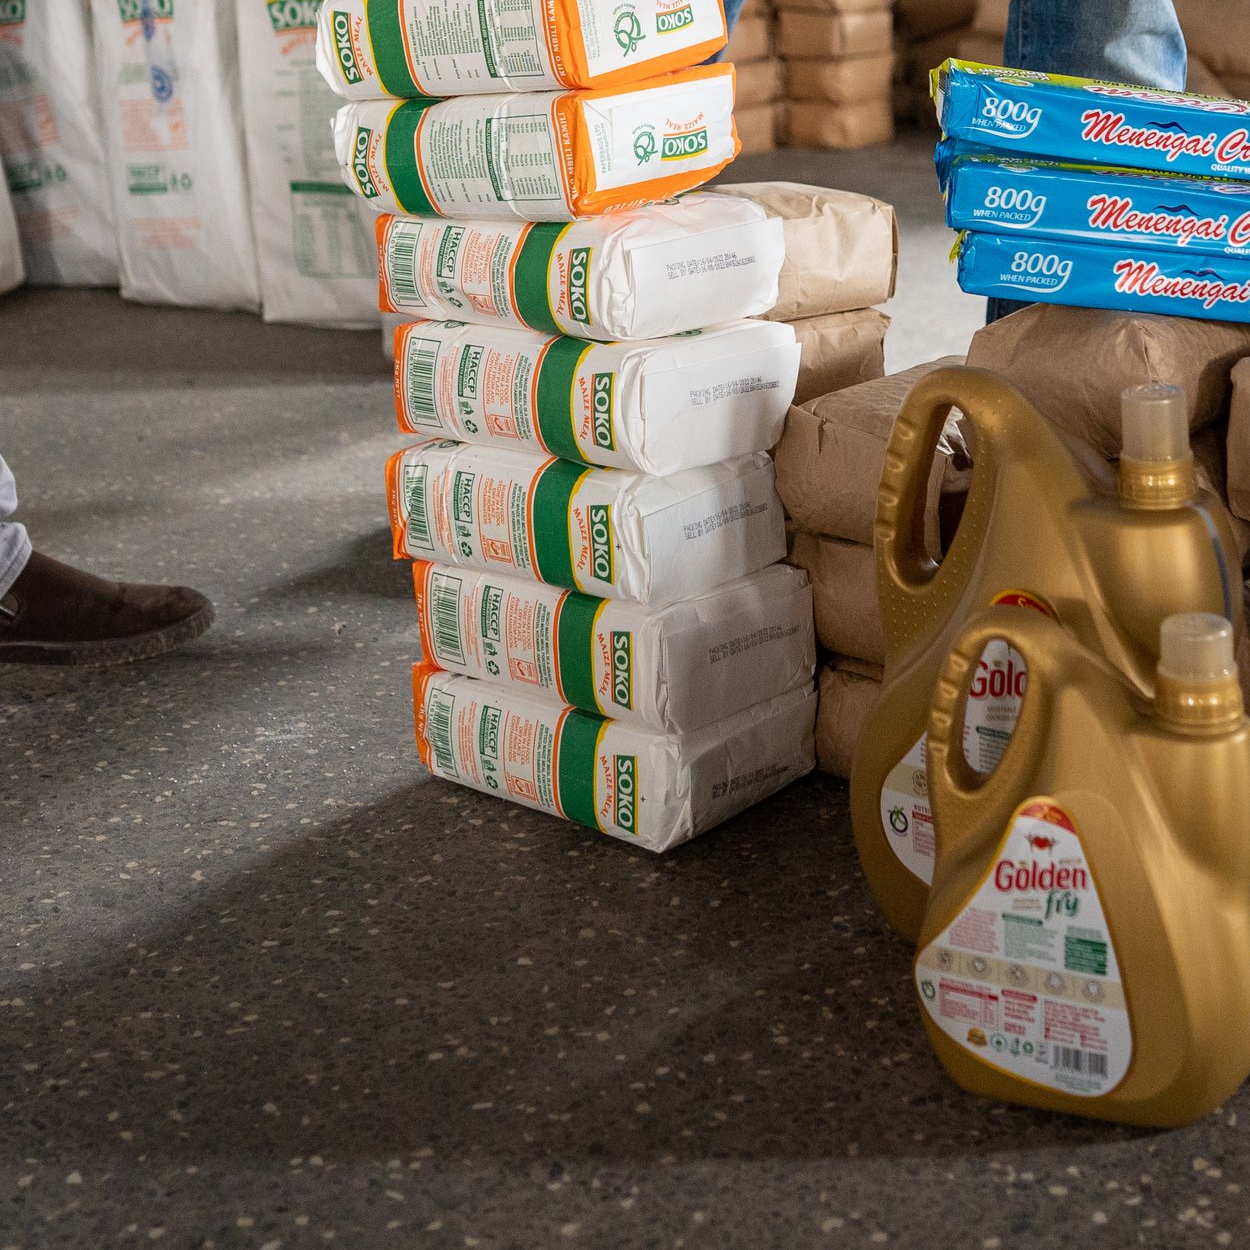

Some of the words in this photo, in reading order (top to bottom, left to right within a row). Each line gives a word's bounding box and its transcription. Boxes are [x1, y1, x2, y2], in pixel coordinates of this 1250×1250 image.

[353, 16, 363, 42] MEAL
[478, 0, 489, 37] INFORMATION
[657, 6, 692, 31] SOKO
[334, 14, 360, 82] SOKO
[550, 25, 560, 52] MBILI
[354, 45, 374, 77] MAIZE
[558, 112, 571, 145] KAMILI
[664, 118, 680, 131] MEAL
[680, 111, 705, 130] MAIZE
[982, 96, 1043, 130] 800g
[370, 133, 382, 160] MEAL
[485, 122, 493, 160] INFORMATION
[665, 133, 707, 155] SOKO
[1081, 109, 1217, 163] Menengai
[354, 131, 376, 196] SOKO
[371, 164, 389, 193] MAIZE
[566, 148, 575, 174] MBILI
[1211, 163, 1243, 175] QUALITY
[973, 208, 999, 219] WHEN
[999, 210, 1032, 222] PACKED
[984, 186, 1047, 223] 800g
[1087, 194, 1228, 247] Menengai
[447, 231, 461, 273] HACCP
[1010, 251, 1074, 287] 800g
[556, 252, 566, 289] MAIZE
[570, 251, 587, 322] SOKO
[1000, 273, 1025, 284] WHEN
[1025, 275, 1058, 287] PACKED
[556, 289, 567, 316] MEAL
[467, 350, 481, 393] HACCP
[578, 376, 589, 414] MAIZE
[594, 376, 611, 447] SOKO
[579, 415, 591, 441] MEAL
[462, 478, 472, 518] HACCP
[573, 507, 589, 541] MAIZE
[577, 542, 589, 570] MEAL
[591, 508, 609, 579] SOKO
[490, 593, 500, 636] HACCP
[597, 632, 611, 668] MAIZE
[598, 668, 611, 696] MEAL
[613, 634, 629, 704] SOKO
[969, 659, 1027, 698] Gol
[489, 713, 499, 753] HACCP
[600, 755, 613, 791] MAIZE
[600, 791, 613, 818] MEAL
[617, 759, 633, 828] SOKO
[994, 858, 1087, 892] Golden
[1044, 890, 1079, 920] fry
